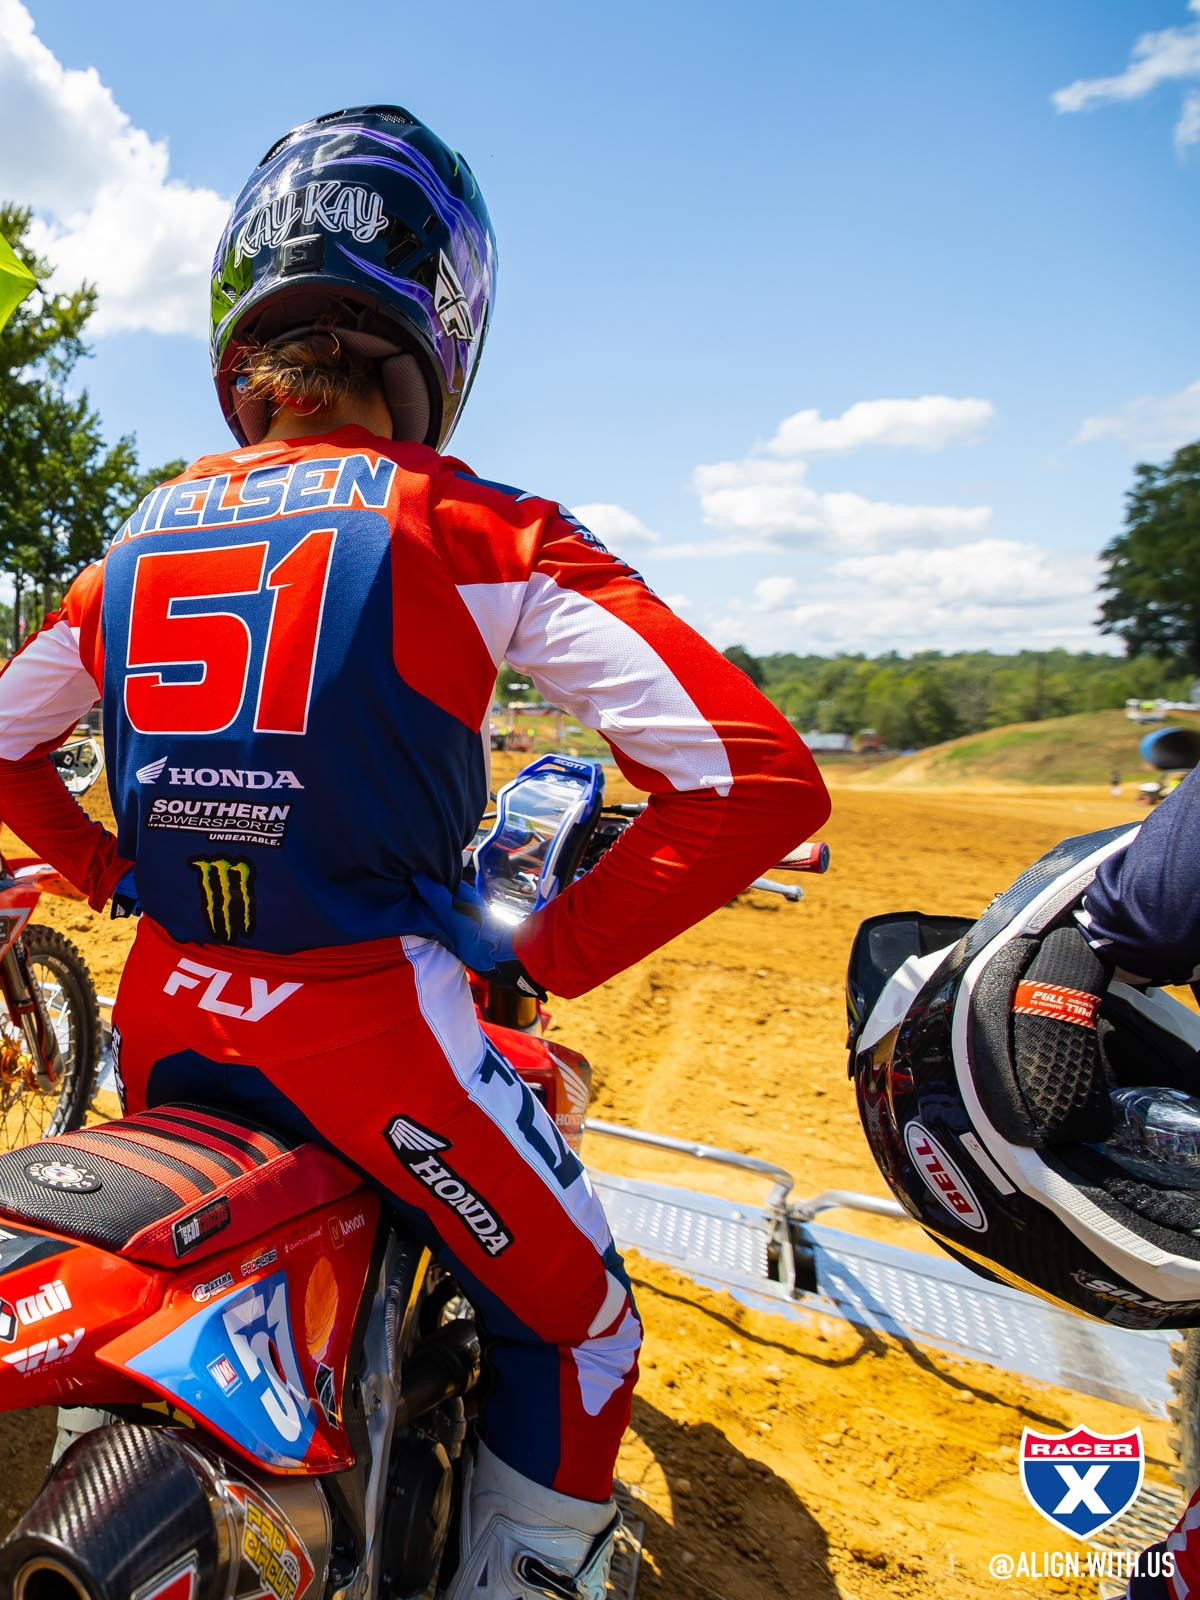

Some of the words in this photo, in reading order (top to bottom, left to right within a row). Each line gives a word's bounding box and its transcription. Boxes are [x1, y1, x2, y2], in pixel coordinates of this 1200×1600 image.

[234, 192, 302, 268] KAY
[302, 181, 389, 243] KAY
[112, 454, 398, 546] NIELSEN
[124, 528, 338, 735] 51
[168, 766, 305, 790] HONDA
[553, 758, 587, 771] SCOTT
[149, 814, 285, 833] POWERSPORTS
[152, 799, 291, 822] SOUTHERN
[163, 957, 304, 1022] FLY
[1032, 991, 1064, 1005] PULL
[915, 1137, 975, 1215] BELL
[409, 1154, 510, 1256] HONDA
[1, 1328, 86, 1374] FLY
[23, 1357, 71, 1379] RACING
[210, 1358, 237, 1389] WMX
[222, 1283, 312, 1442] 51
[247, 1502, 286, 1557] PRO
[243, 1528, 297, 1600] CIRCUIT
